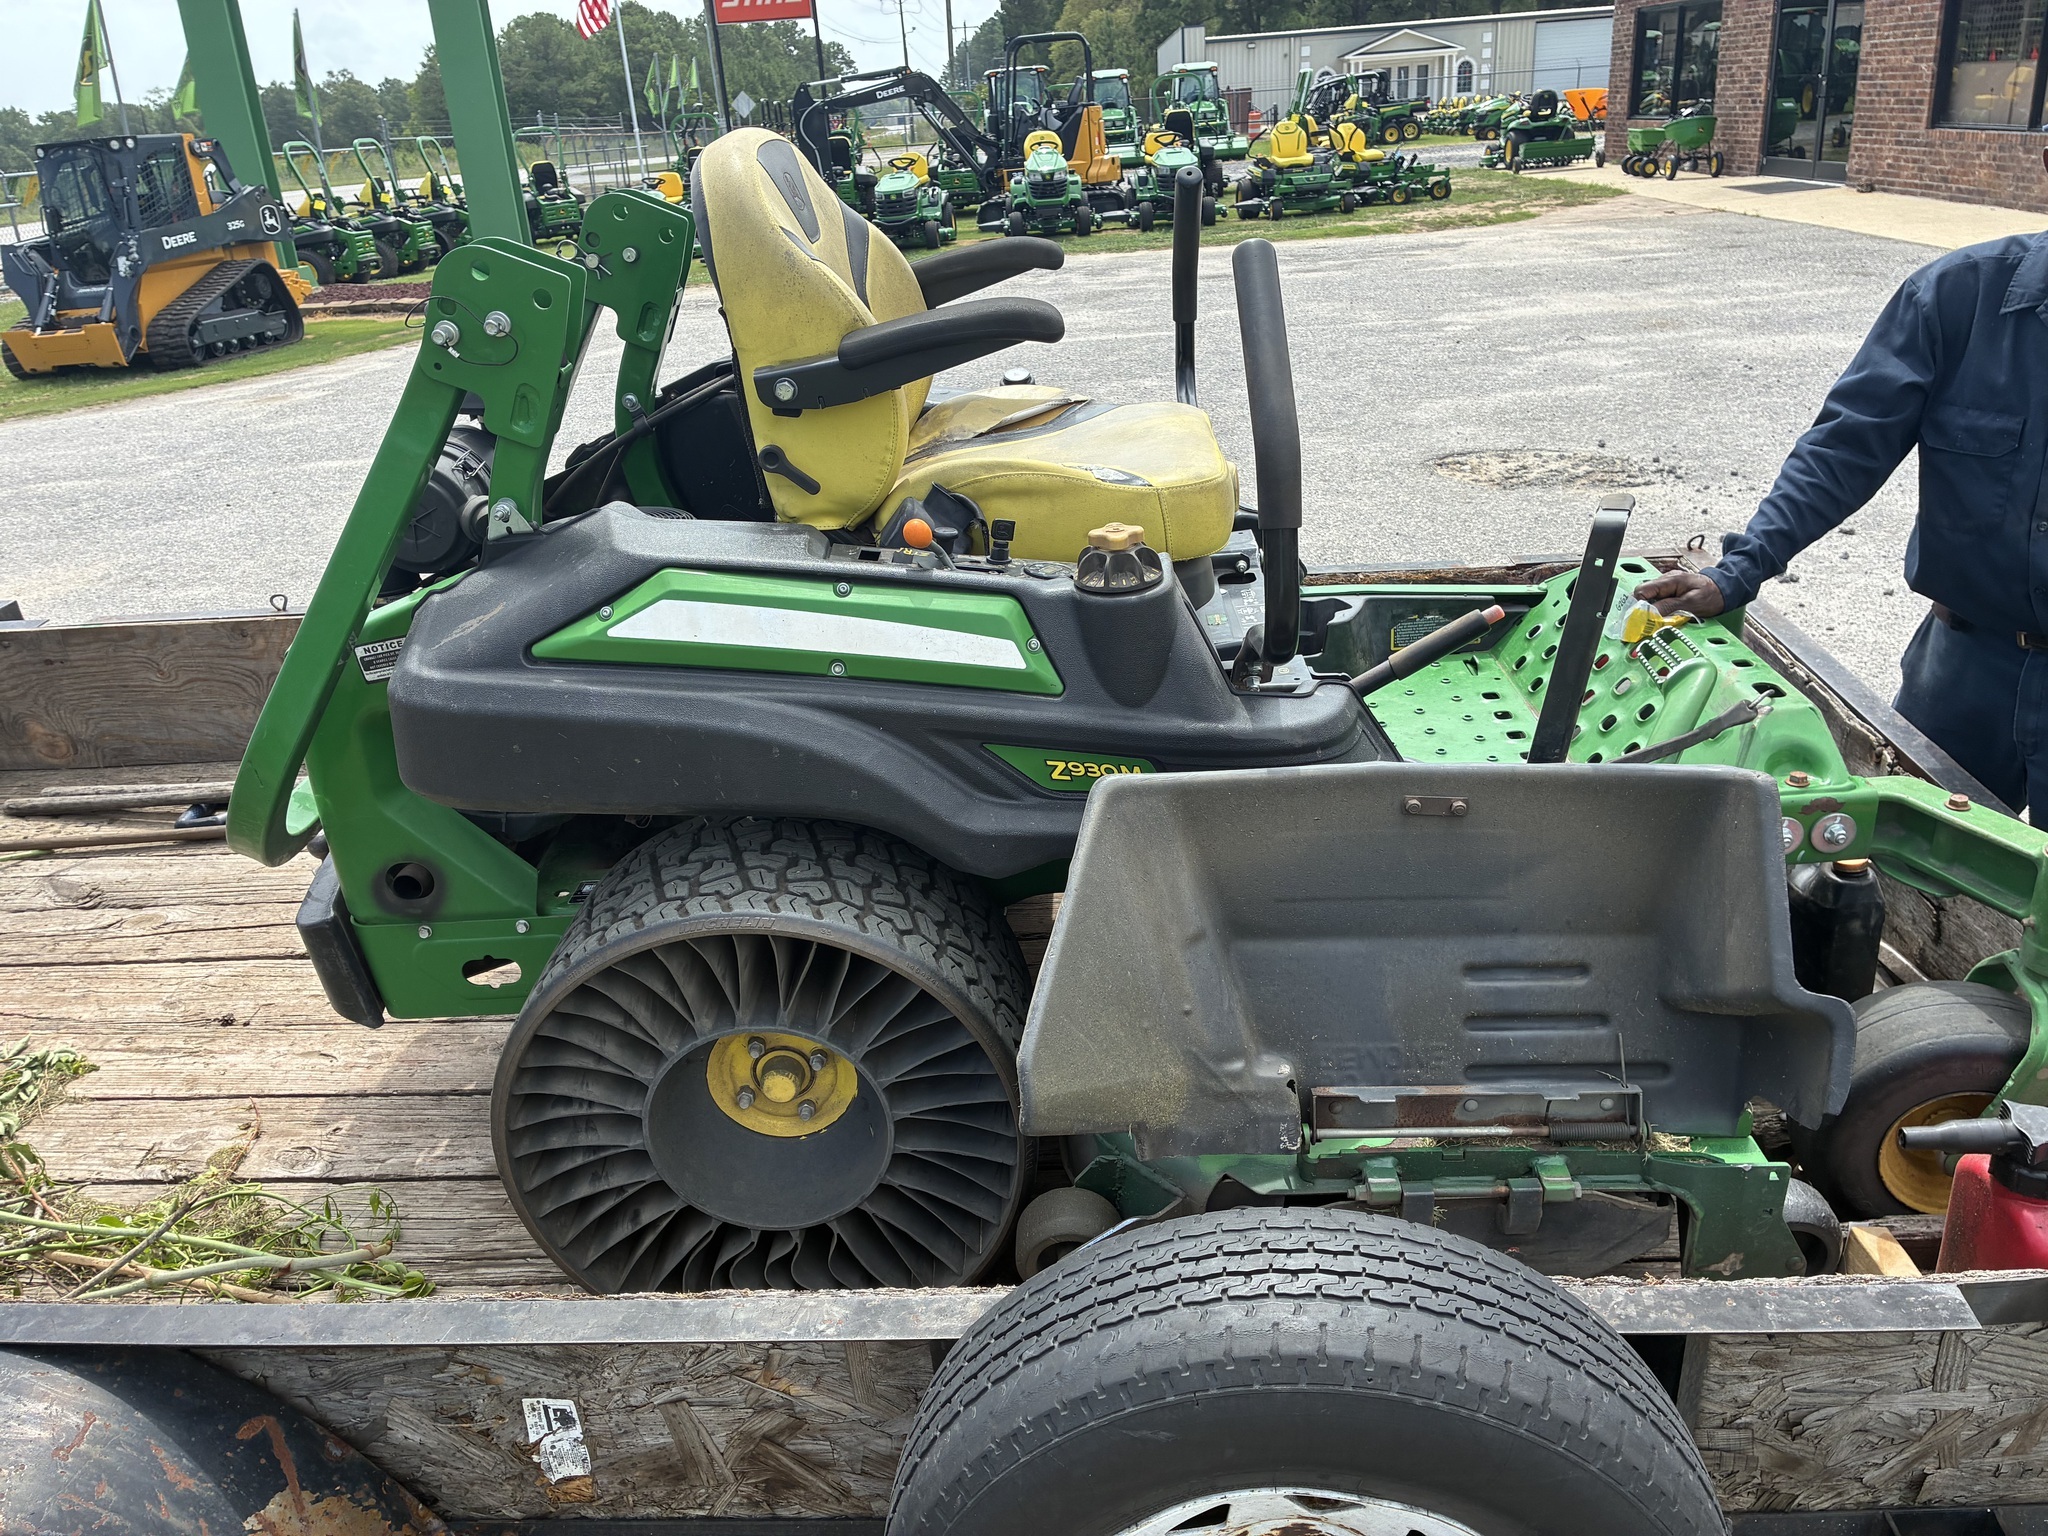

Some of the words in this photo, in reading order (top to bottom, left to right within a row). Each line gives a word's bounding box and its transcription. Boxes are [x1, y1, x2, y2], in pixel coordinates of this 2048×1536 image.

[875, 85, 906, 100] DEERE
[161, 231, 198, 250] DEERE
[362, 640, 403, 655] NOTICE
[679, 916, 776, 934] MICHELIN
